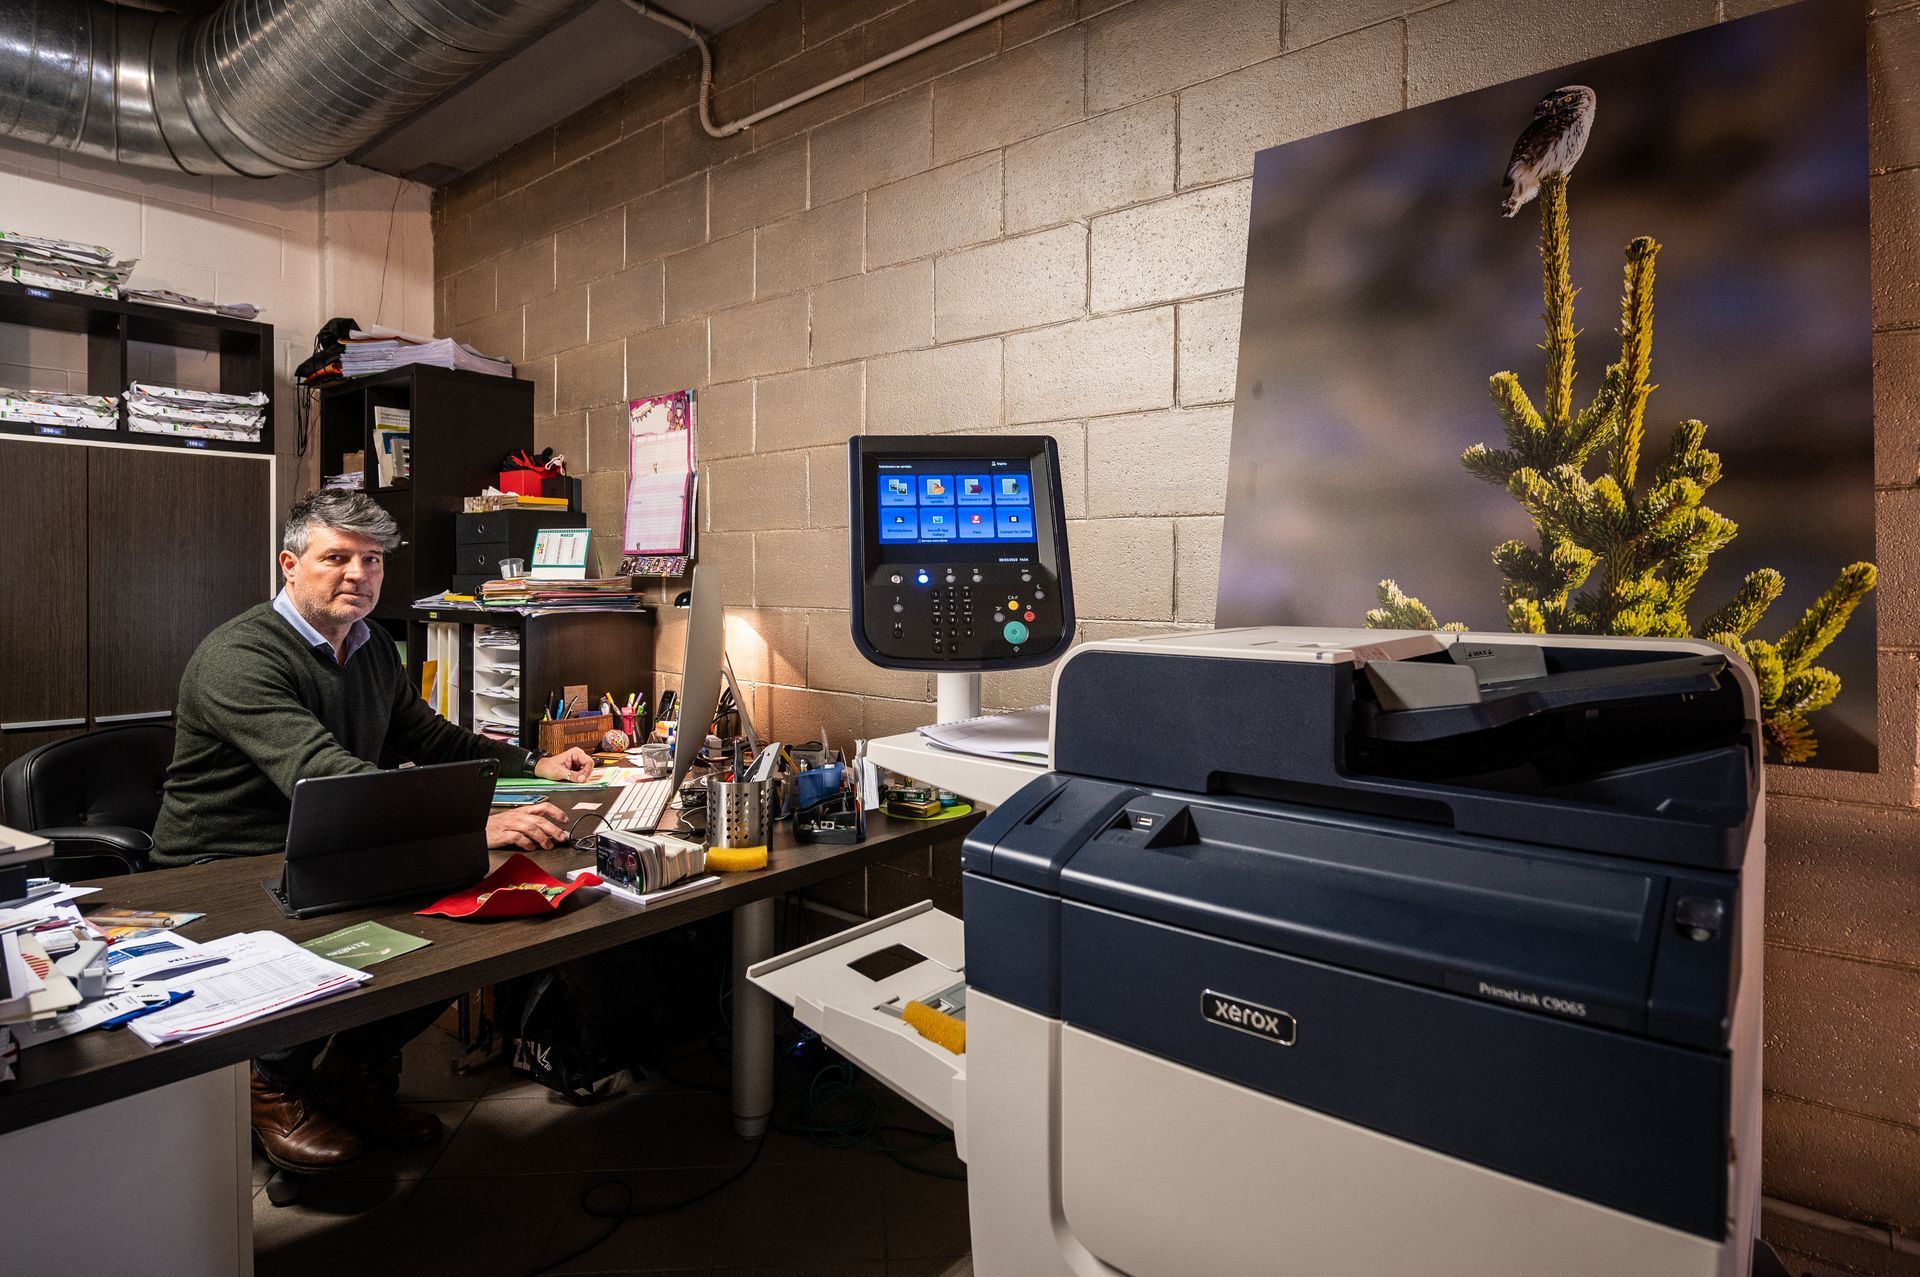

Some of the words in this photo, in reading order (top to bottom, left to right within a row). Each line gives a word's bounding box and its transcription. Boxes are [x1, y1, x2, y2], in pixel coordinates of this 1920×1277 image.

[1478, 982, 1540, 1006] PrimeLink
[1541, 996, 1587, 1016] C9065
[1214, 999, 1280, 1034] xerox
